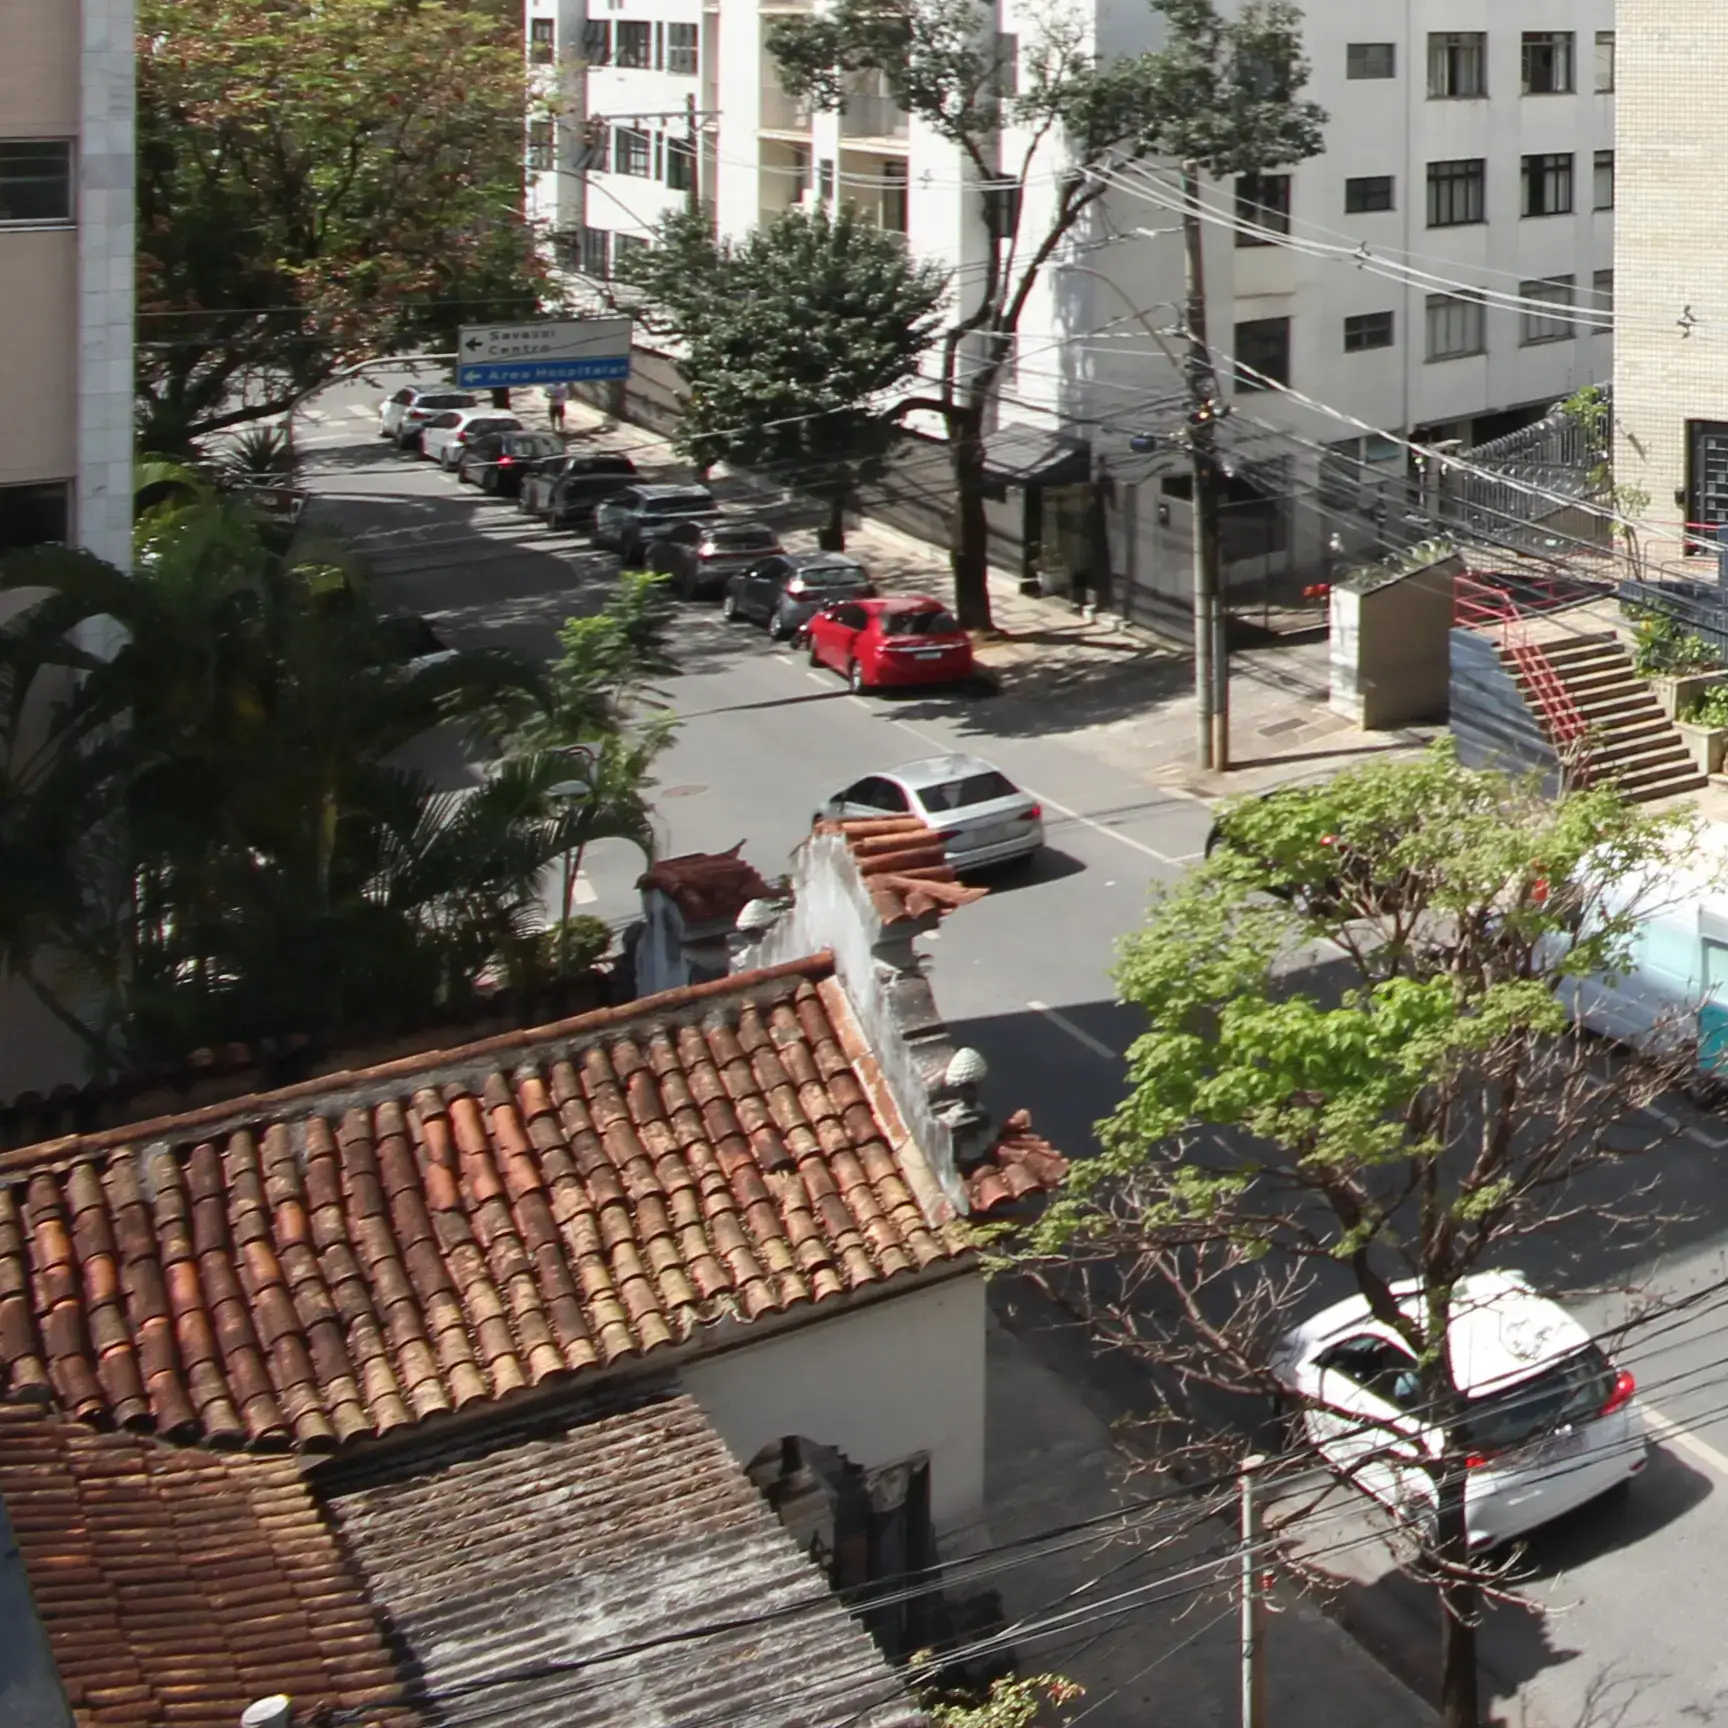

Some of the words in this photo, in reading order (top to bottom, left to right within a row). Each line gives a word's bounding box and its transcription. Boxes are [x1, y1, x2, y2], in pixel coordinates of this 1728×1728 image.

[489, 329, 556, 341] Savassi
[488, 344, 550, 355] Centro
[535, 365, 627, 378] Hospitalar
